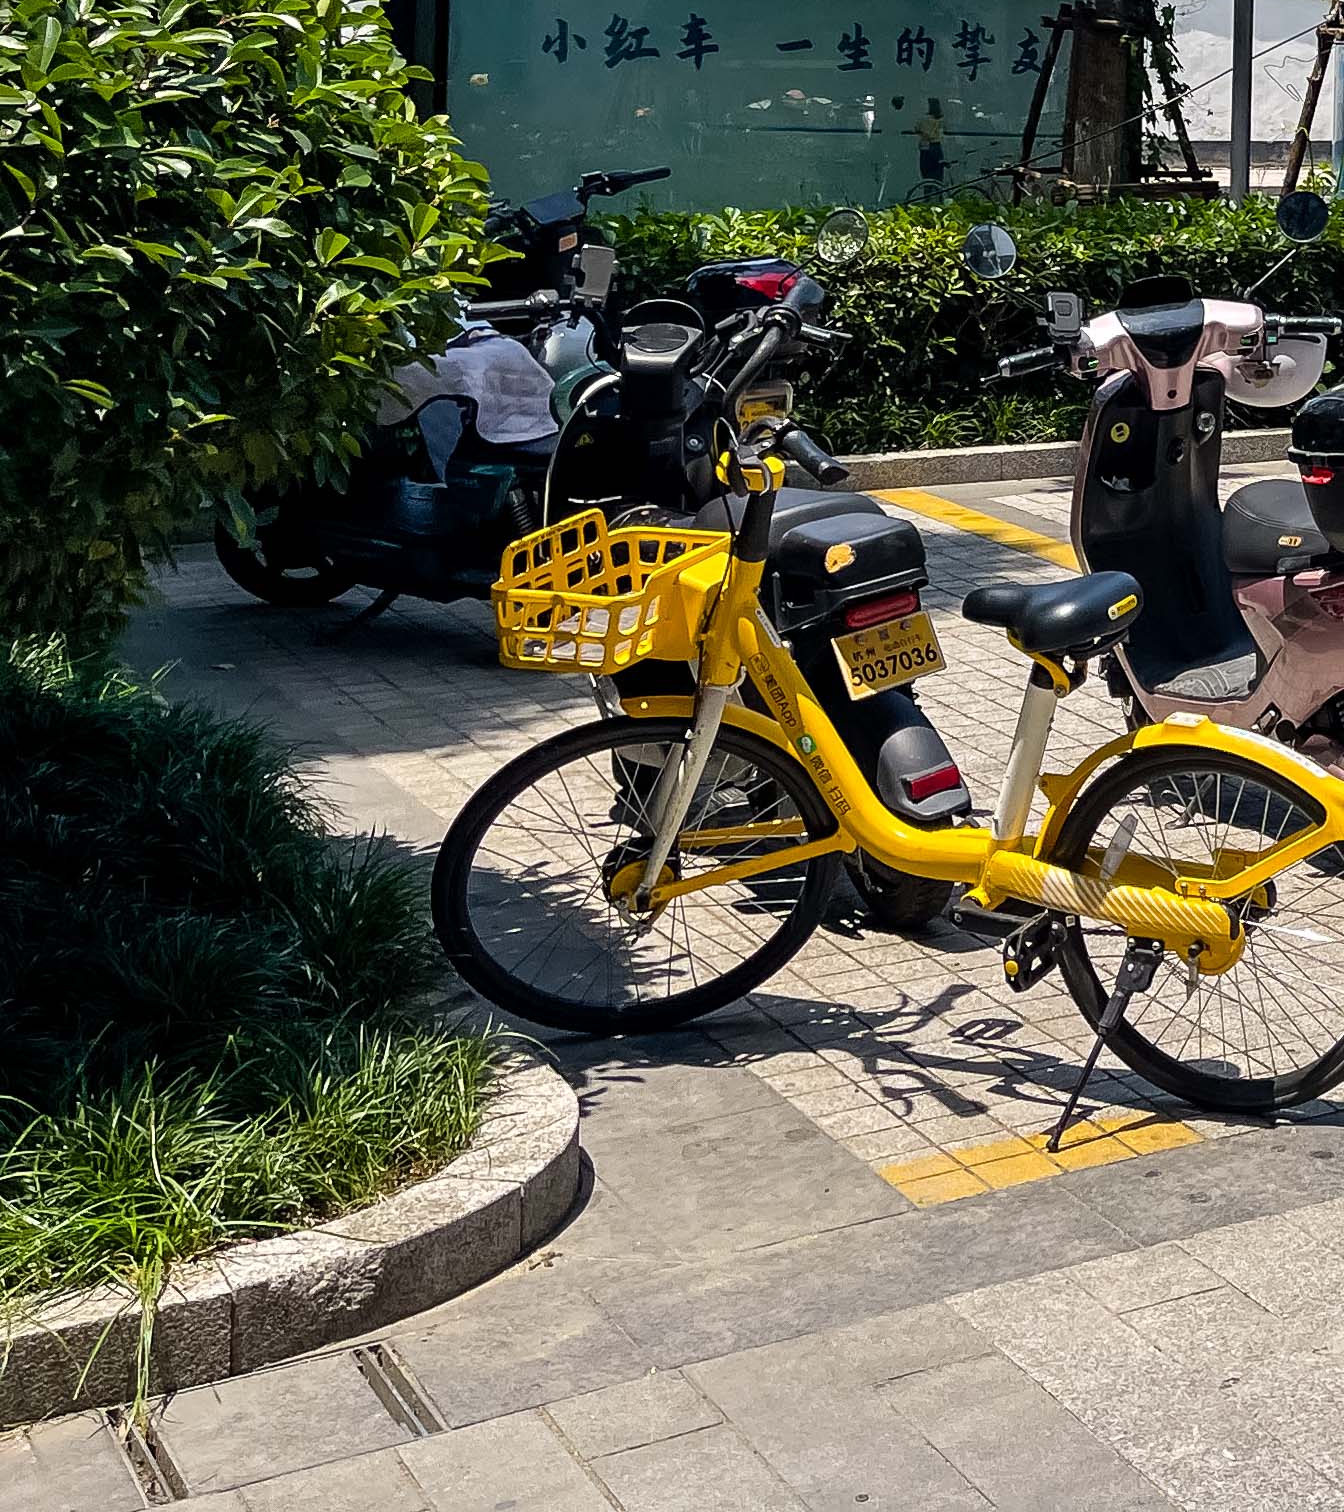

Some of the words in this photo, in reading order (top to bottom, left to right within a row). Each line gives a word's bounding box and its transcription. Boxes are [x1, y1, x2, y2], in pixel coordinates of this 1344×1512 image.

[541, 13, 720, 71] 小红车
[851, 642, 938, 687] 5037036
